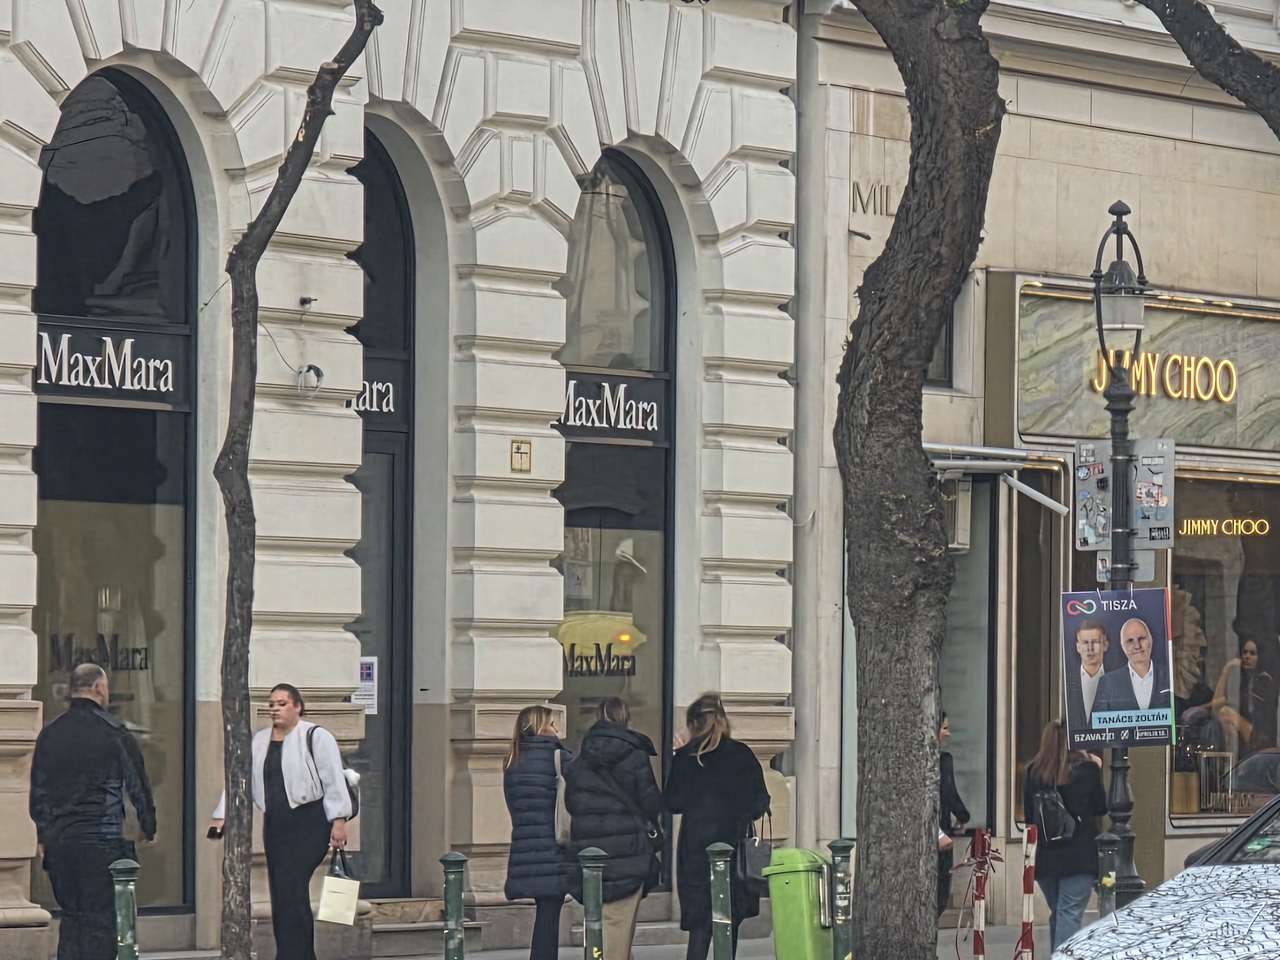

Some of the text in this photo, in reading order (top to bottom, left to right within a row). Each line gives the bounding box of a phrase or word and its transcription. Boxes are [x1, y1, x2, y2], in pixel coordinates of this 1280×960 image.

[37, 331, 174, 392] MaxMara
[1164, 354, 1238, 402] CHOO
[1179, 519, 1219, 535] JIMMY
[1221, 519, 1269, 535] CHOO
[1101, 600, 1138, 611] TISZA
[1097, 711, 1168, 724] TANÁCS ZOLTÁN
